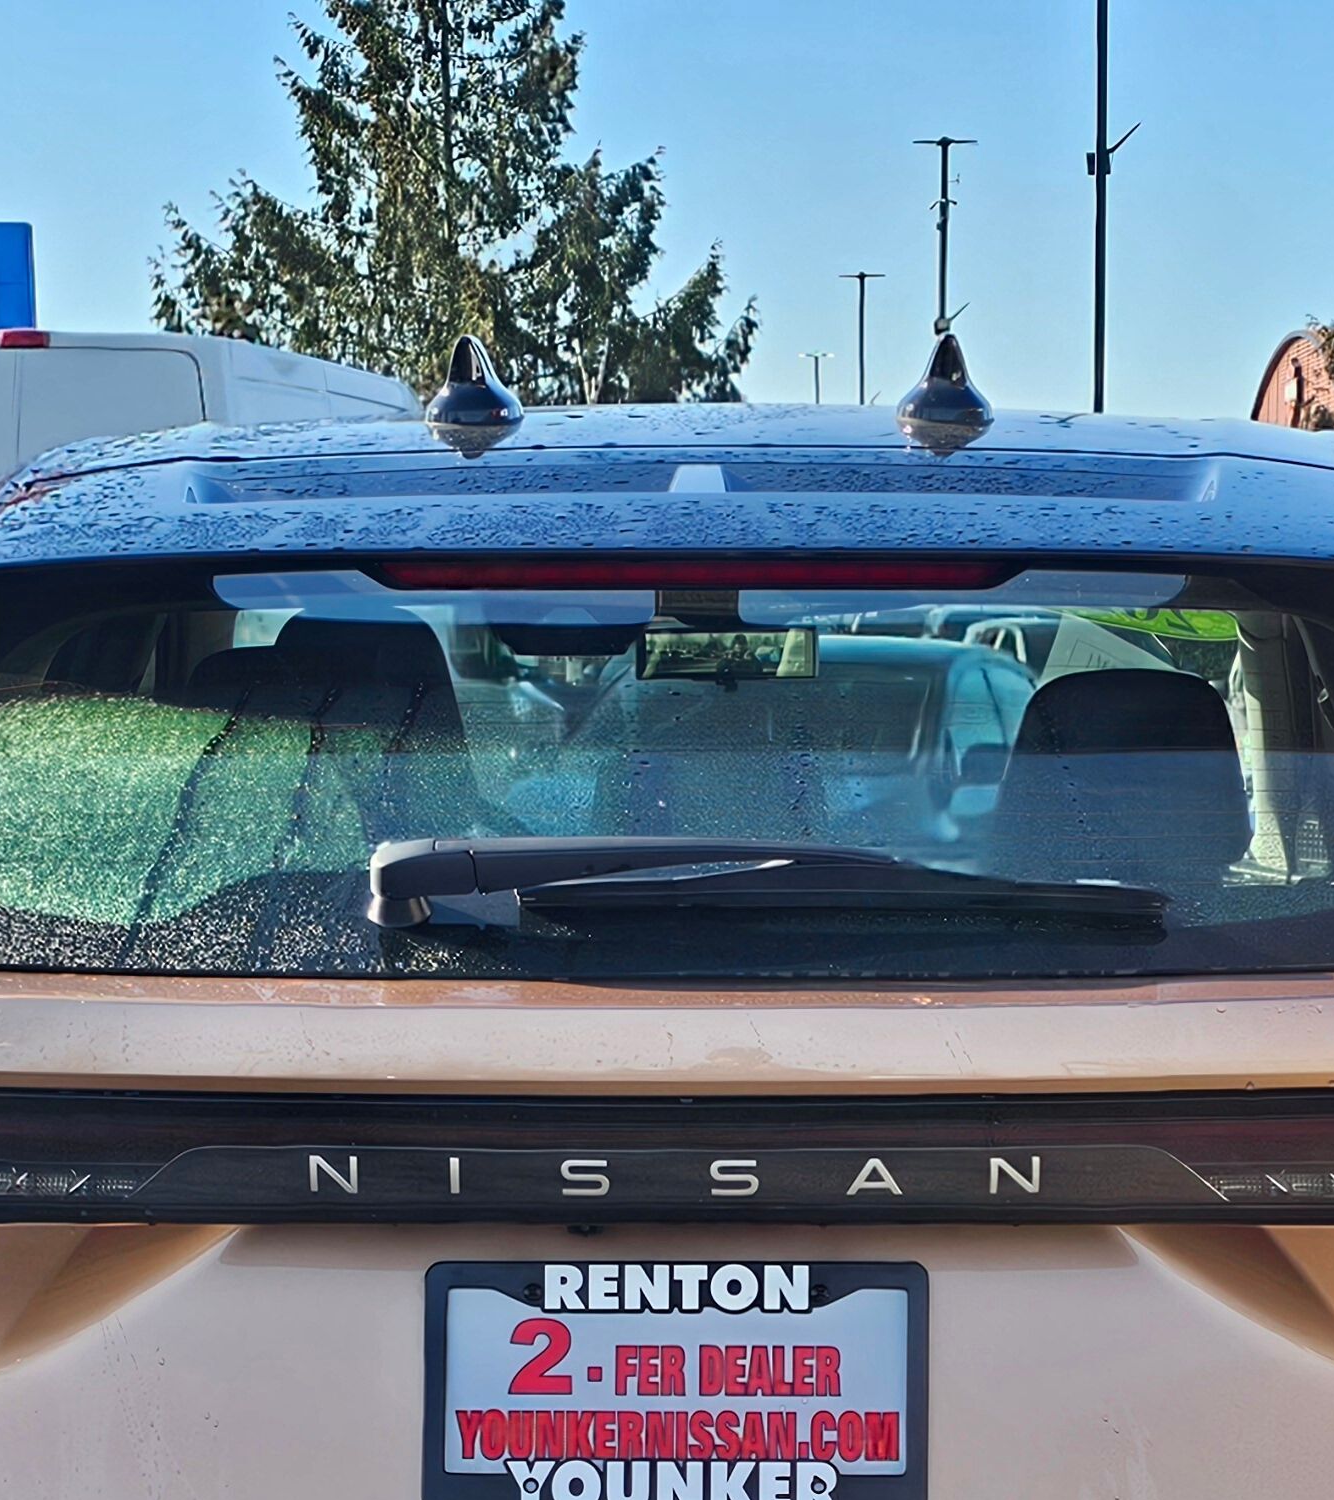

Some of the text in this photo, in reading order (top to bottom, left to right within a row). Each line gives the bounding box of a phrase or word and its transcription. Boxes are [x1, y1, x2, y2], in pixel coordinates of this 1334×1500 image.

[308, 1155, 1041, 1195] NISSAN
[544, 1263, 810, 1311] RENTON
[699, 1345, 842, 1397] DEALER
[455, 1409, 900, 1462] YOUNKERNISSAN.COM
